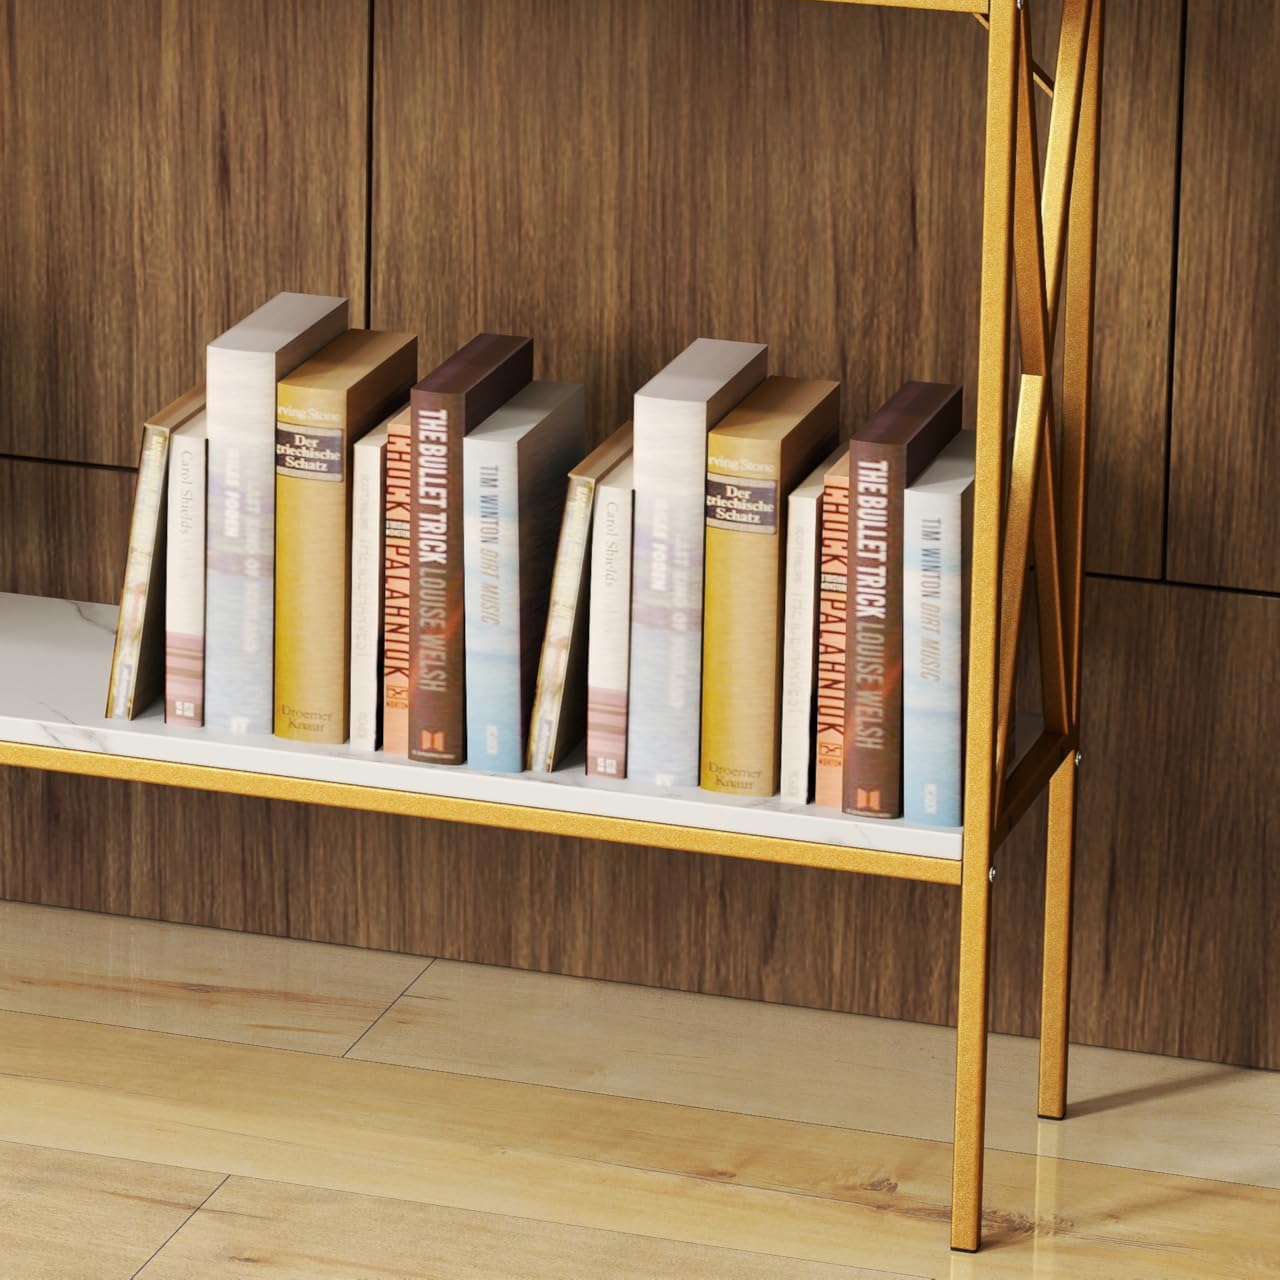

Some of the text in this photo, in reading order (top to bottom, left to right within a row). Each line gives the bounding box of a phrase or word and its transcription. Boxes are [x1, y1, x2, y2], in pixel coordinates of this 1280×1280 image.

[277, 406, 306, 420] rving
[295, 435, 319, 448] Der
[180, 450, 193, 535] Carol Shields
[286, 456, 329, 472] Schatz
[386, 434, 411, 513] CHUCK
[708, 456, 738, 472] rving
[726, 486, 752, 499] Der
[418, 409, 448, 692] THE BULLET TRICK LOUISE WELSH
[479, 465, 499, 625] TIM WINTON DIRT MUSIC
[604, 502, 618, 588] Carol Shields
[717, 508, 761, 523] Schatz
[822, 486, 849, 566] CHUCK
[385, 544, 410, 678] PALAHNIUK
[854, 460, 889, 749] THE BULLET TRICK LOUISE WELSH
[920, 518, 941, 682] TIM WINTON DIRT MUSIC
[818, 598, 847, 735] PALAHNIUK
[708, 760, 762, 778] Droemer
